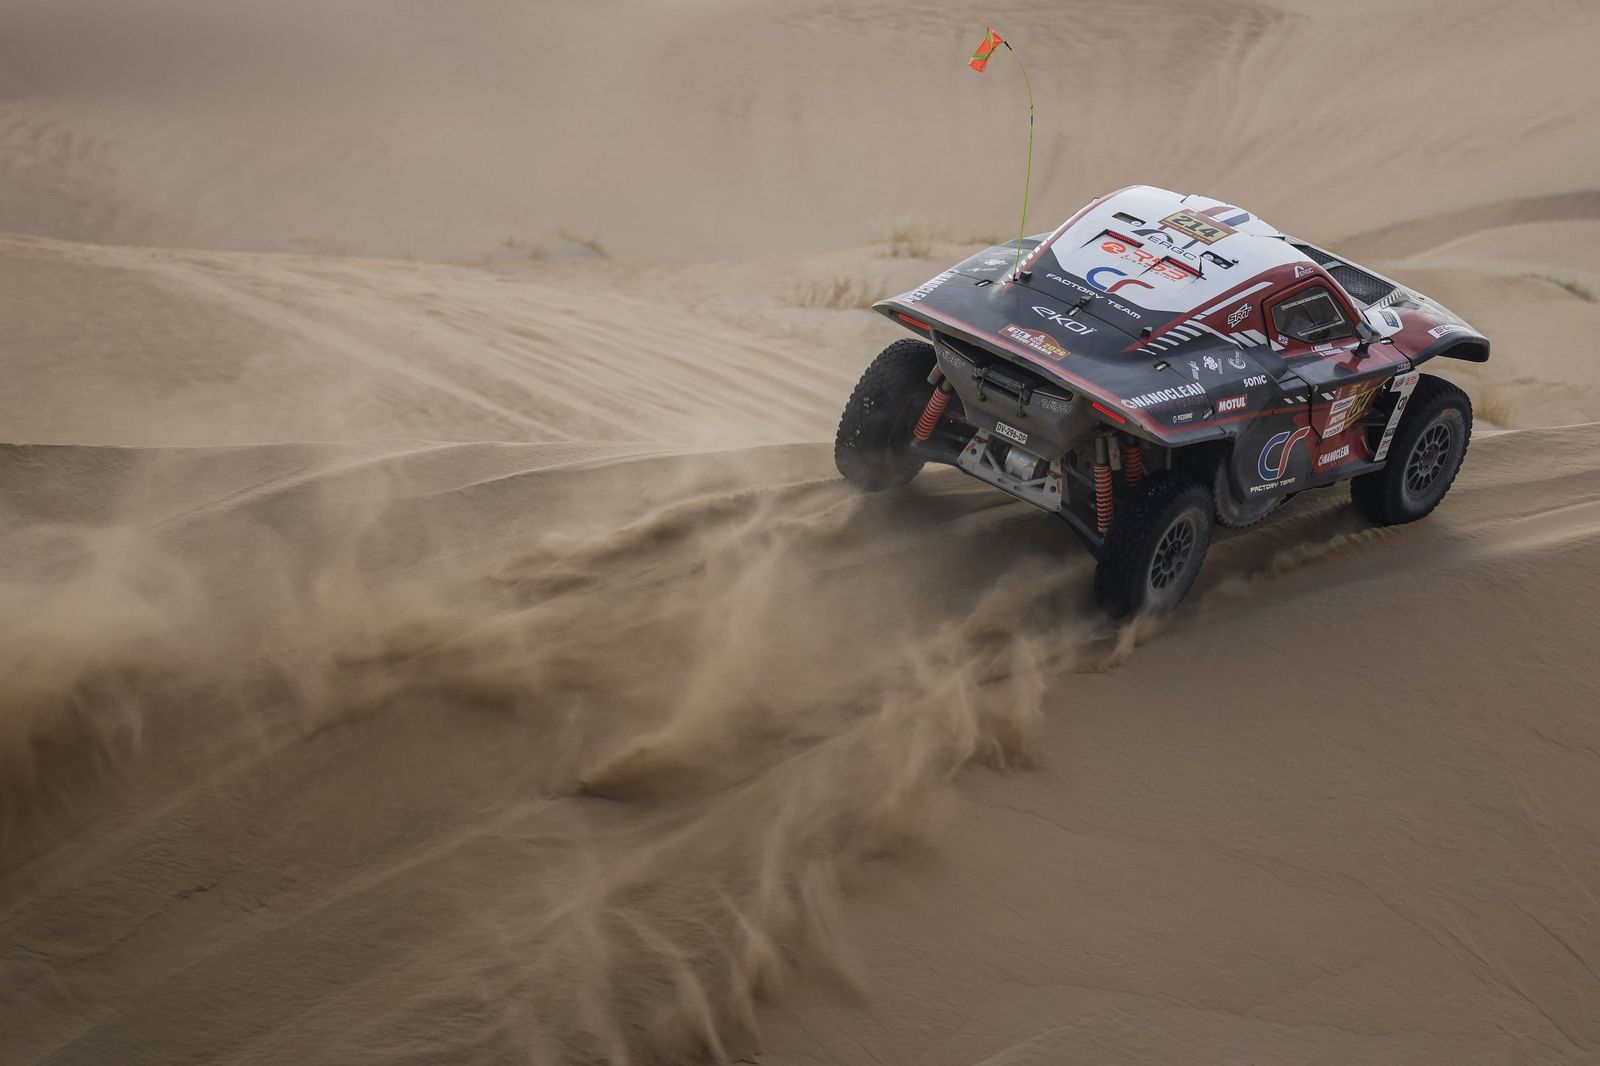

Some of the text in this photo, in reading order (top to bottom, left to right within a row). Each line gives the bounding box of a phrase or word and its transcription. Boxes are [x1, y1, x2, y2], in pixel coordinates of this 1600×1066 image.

[1171, 215, 1220, 238] 214
[1046, 273, 1142, 320] FACTORY TEAM
[1132, 382, 1206, 408] NANOCLEAN
[1218, 396, 1247, 412] MOTUL
[997, 423, 1027, 443] DV-296-DP
[1250, 477, 1296, 493] FACTORY TEAM
